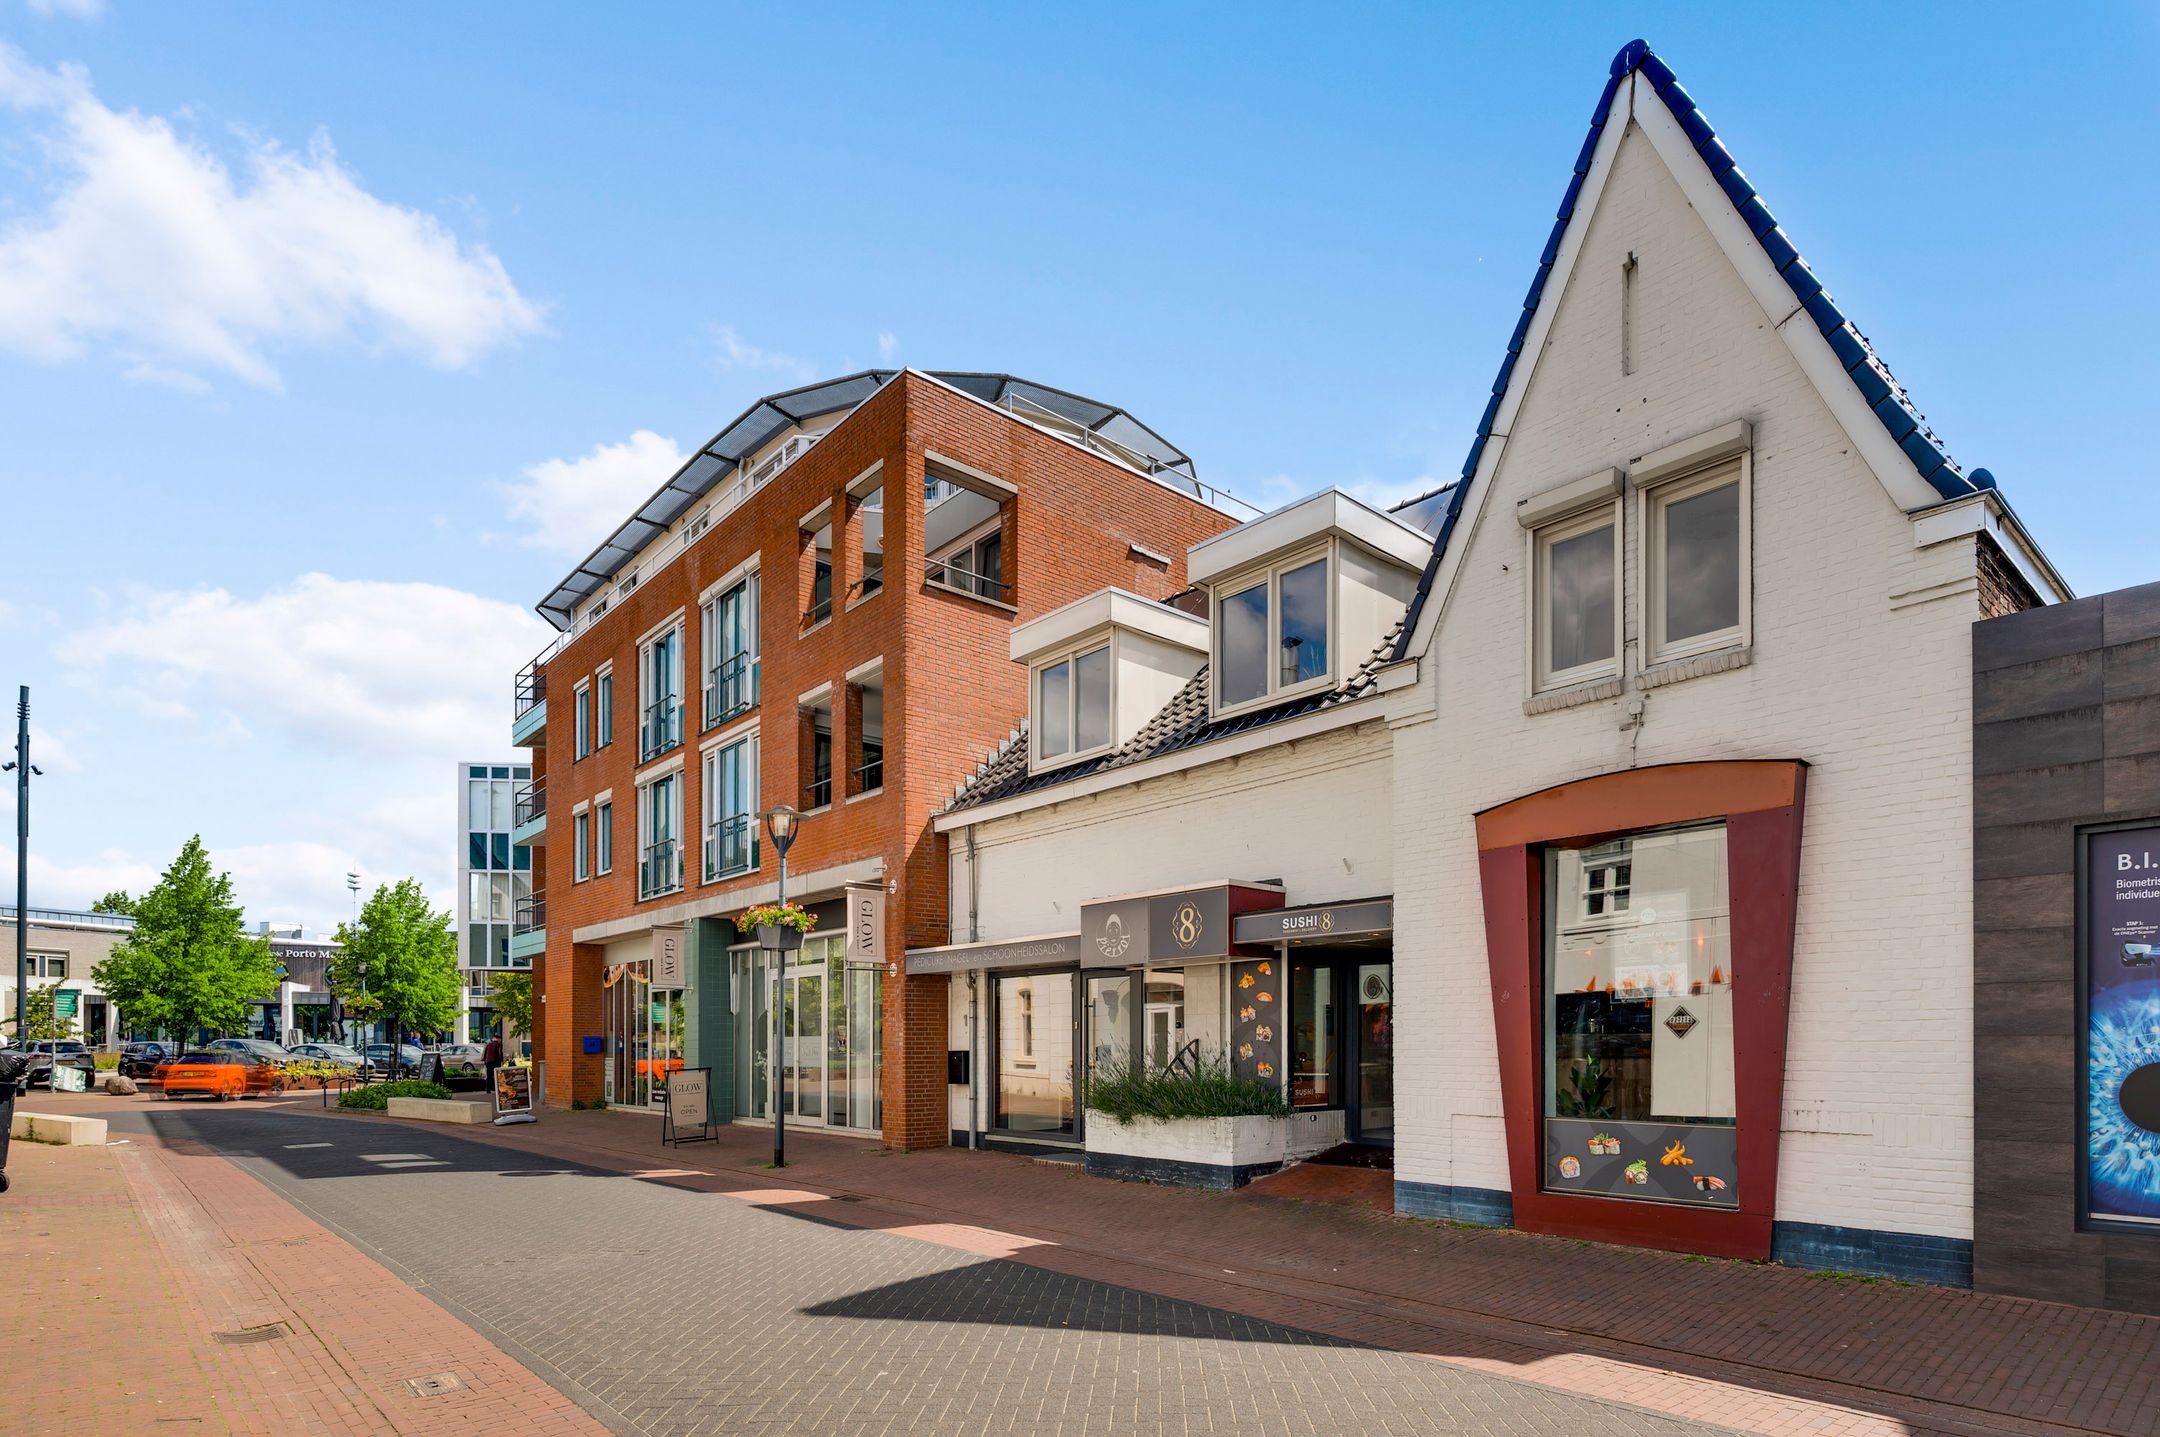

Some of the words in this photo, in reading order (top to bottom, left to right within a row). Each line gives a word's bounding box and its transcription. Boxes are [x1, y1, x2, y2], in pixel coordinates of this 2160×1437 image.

[861, 900, 873, 954] GLOW
[1179, 907, 1195, 943] 8
[1282, 915, 1318, 930] SUSHI
[1322, 912, 1331, 930] 8
[285, 949, 317, 958] Porto
[664, 938, 675, 978] GLOW
[983, 943, 1066, 960] SCHOONHEIDSSALON
[674, 1082, 703, 1093] GLOW
[1294, 1088, 1314, 1096] SUSHI
